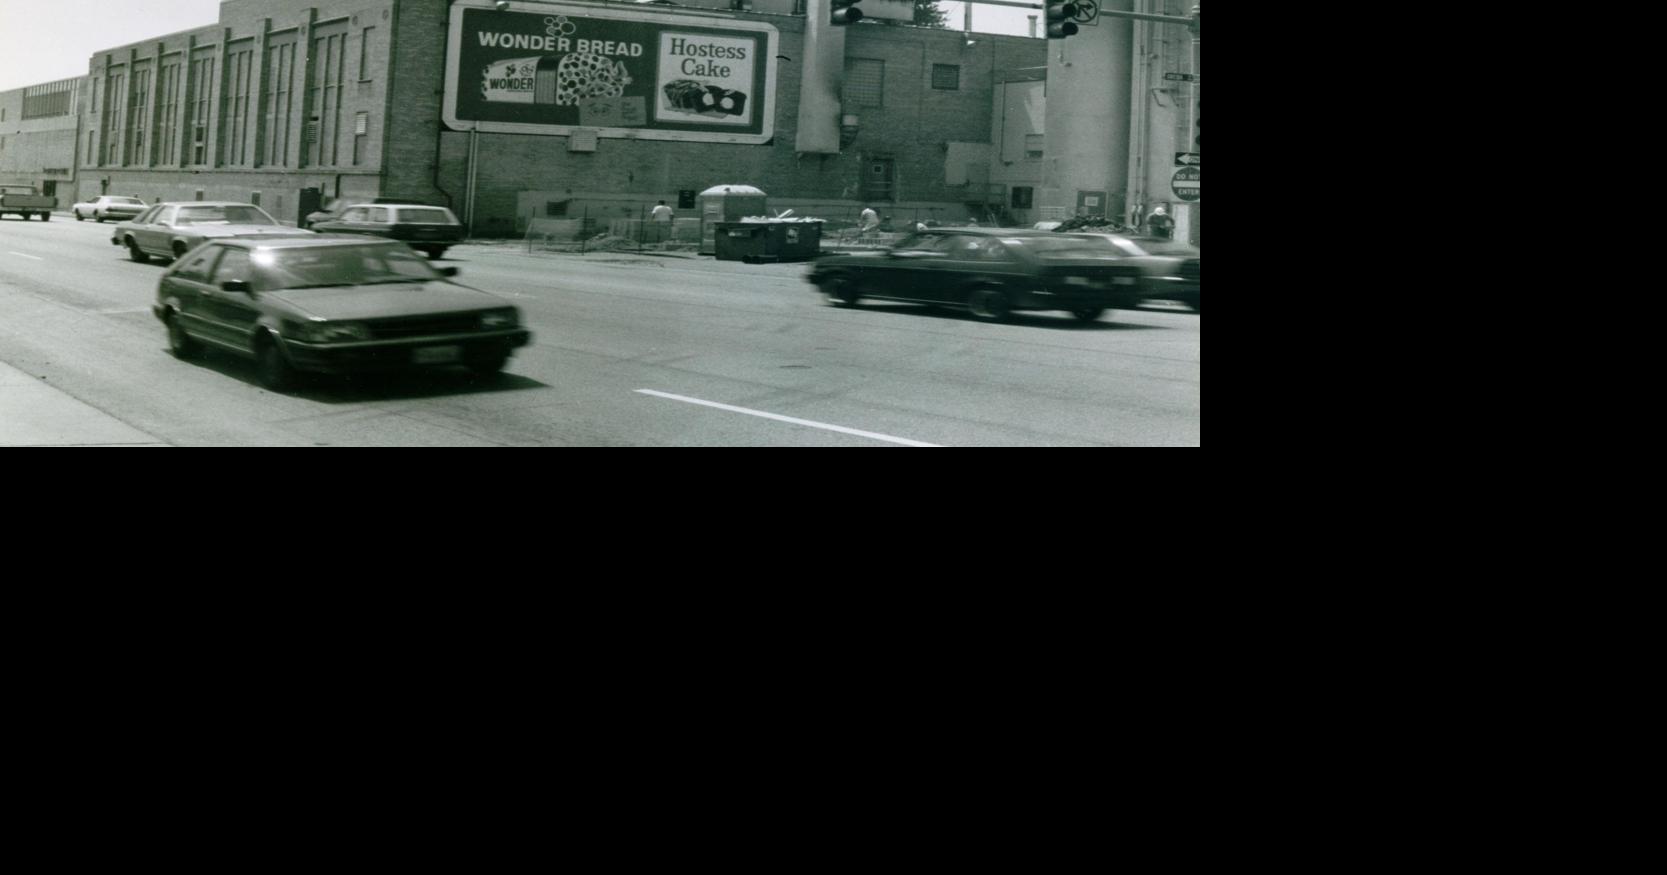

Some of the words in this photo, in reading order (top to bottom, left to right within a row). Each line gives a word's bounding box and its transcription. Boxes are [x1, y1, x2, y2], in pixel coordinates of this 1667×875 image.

[478, 31, 571, 52] WONDER
[576, 38, 643, 57] BREAD
[669, 37, 747, 60] Hostess
[681, 58, 731, 78] Cake
[489, 77, 534, 90] WONDER
[1188, 173, 1200, 181] NO
